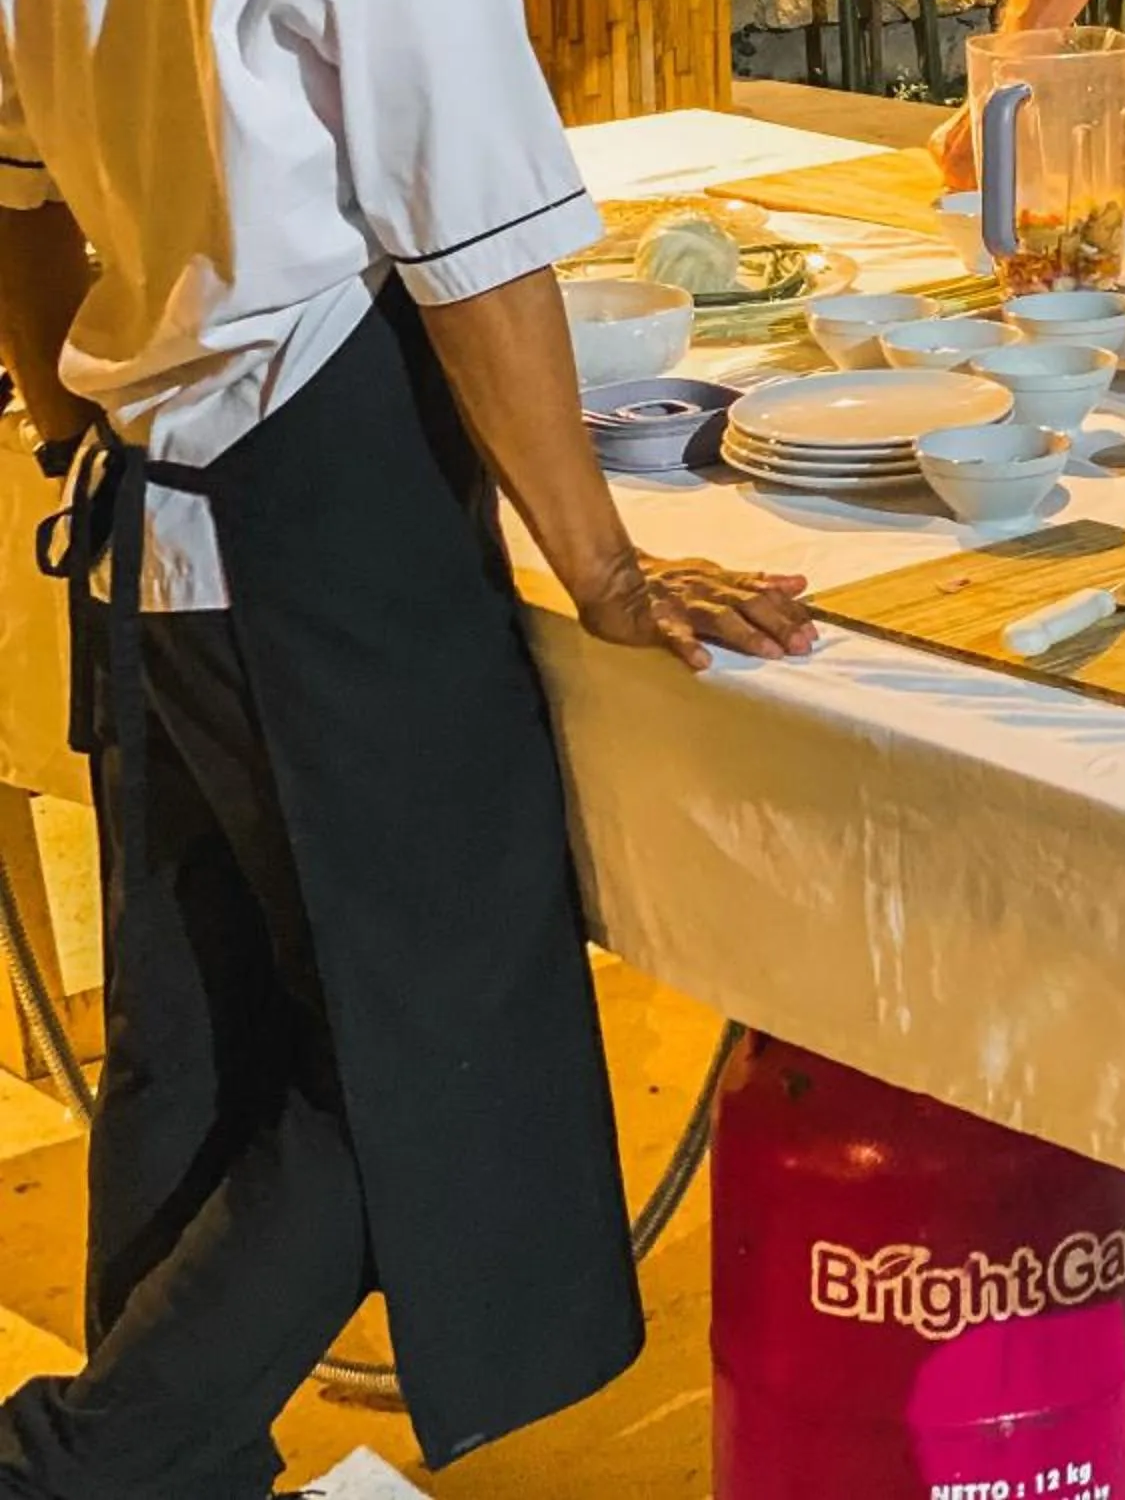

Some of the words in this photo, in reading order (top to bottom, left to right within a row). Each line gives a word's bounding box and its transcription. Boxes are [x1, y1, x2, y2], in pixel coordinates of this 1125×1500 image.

[811, 1240, 1045, 1340] Bright
[931, 1480, 1009, 1500] NETTO
[1035, 1468, 1060, 1493] 12
[1066, 1461, 1092, 1486] kg
